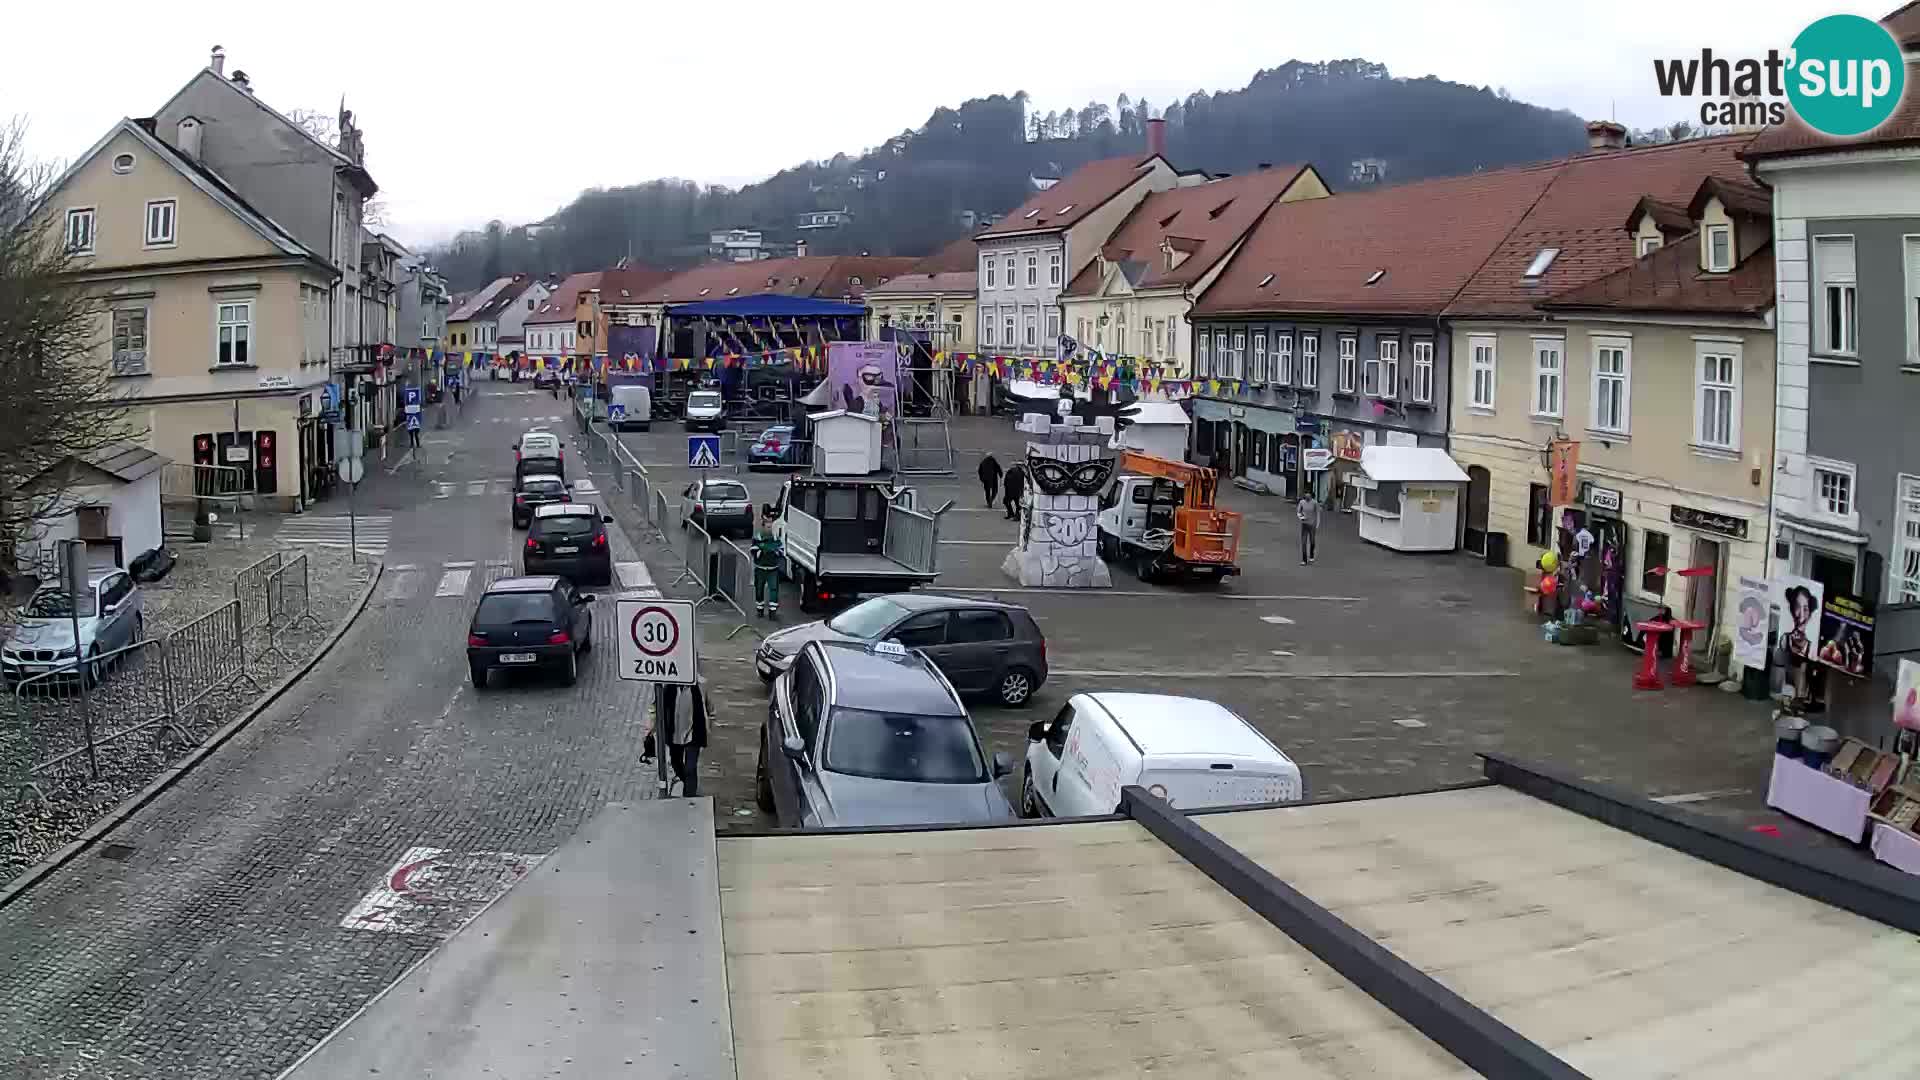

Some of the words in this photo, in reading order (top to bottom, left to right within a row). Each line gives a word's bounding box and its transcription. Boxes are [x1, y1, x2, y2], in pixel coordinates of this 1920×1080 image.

[408, 391, 416, 402] P
[1048, 517, 1087, 545] 200
[643, 622, 668, 643] 30
[633, 660, 678, 676] ZONA
